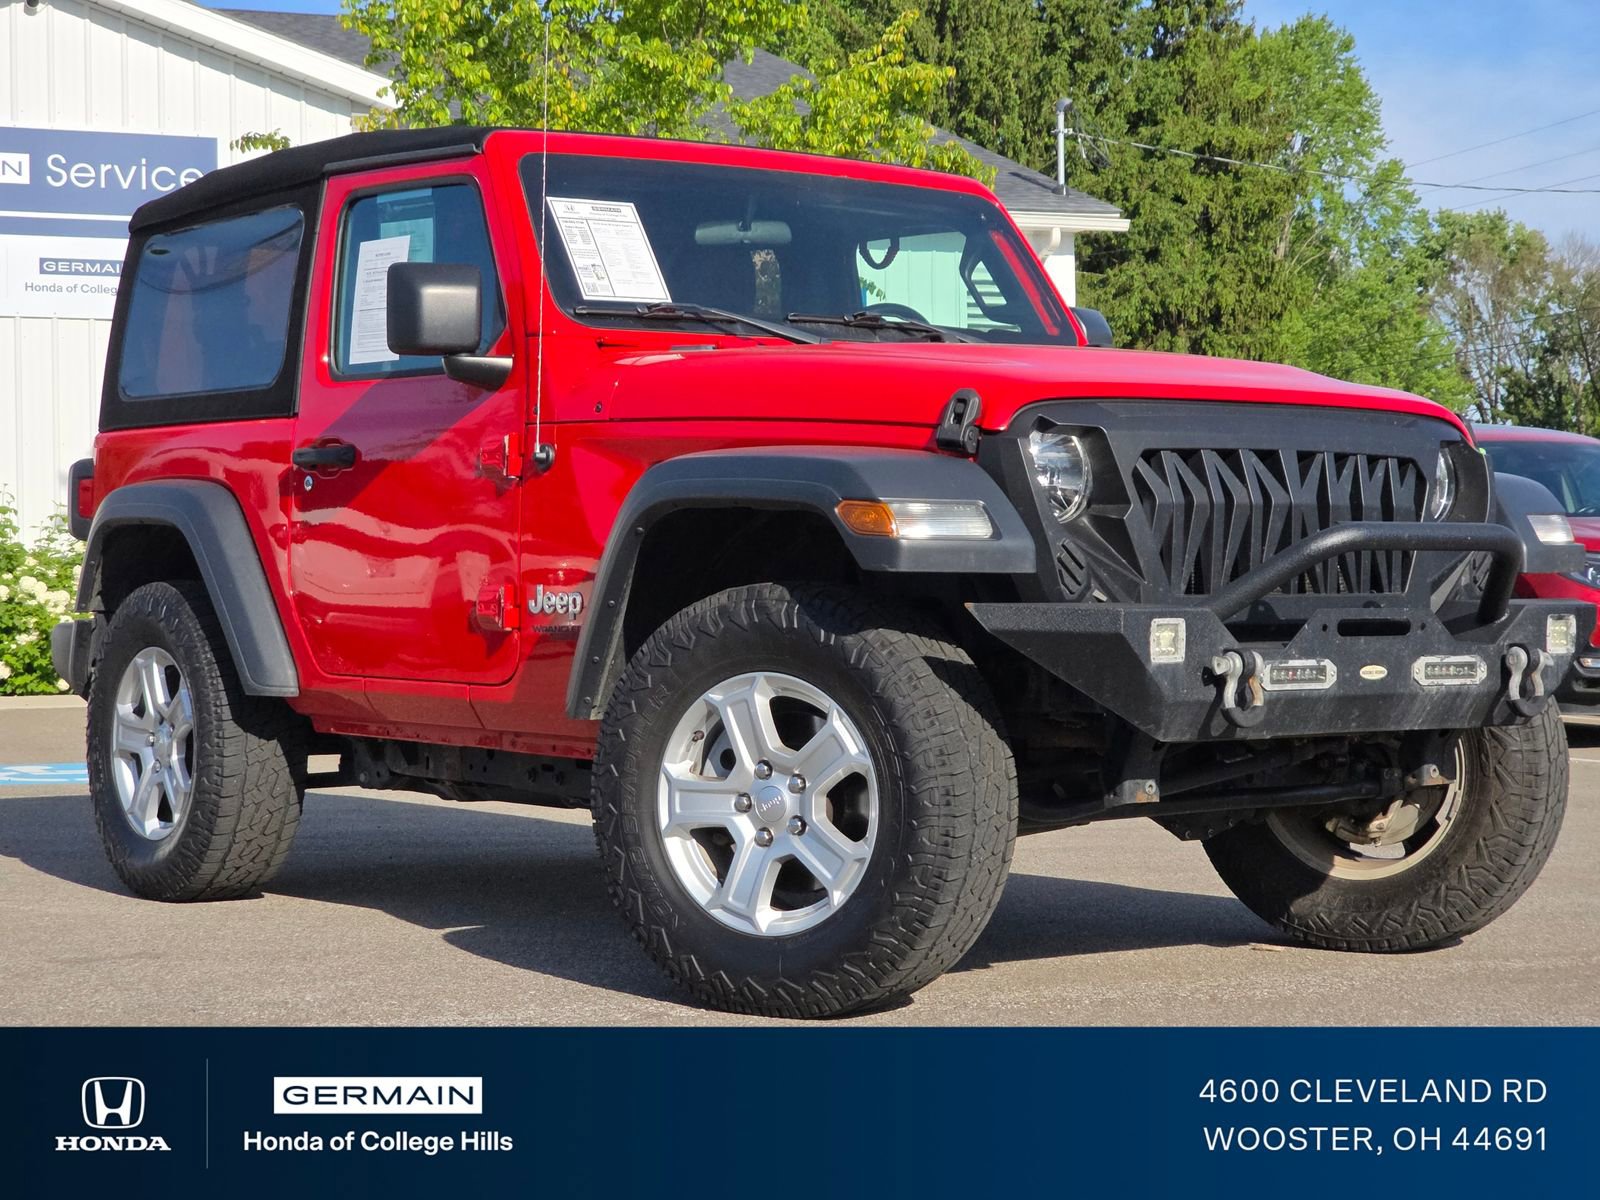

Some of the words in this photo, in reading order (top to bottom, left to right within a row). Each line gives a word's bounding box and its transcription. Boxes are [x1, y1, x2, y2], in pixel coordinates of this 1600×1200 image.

[46, 153, 204, 192] Service
[43, 261, 121, 273] GERMAI
[25, 281, 63, 293] Honda
[65, 283, 78, 293] of
[80, 283, 118, 297] Colleg
[528, 584, 583, 620] Jeep
